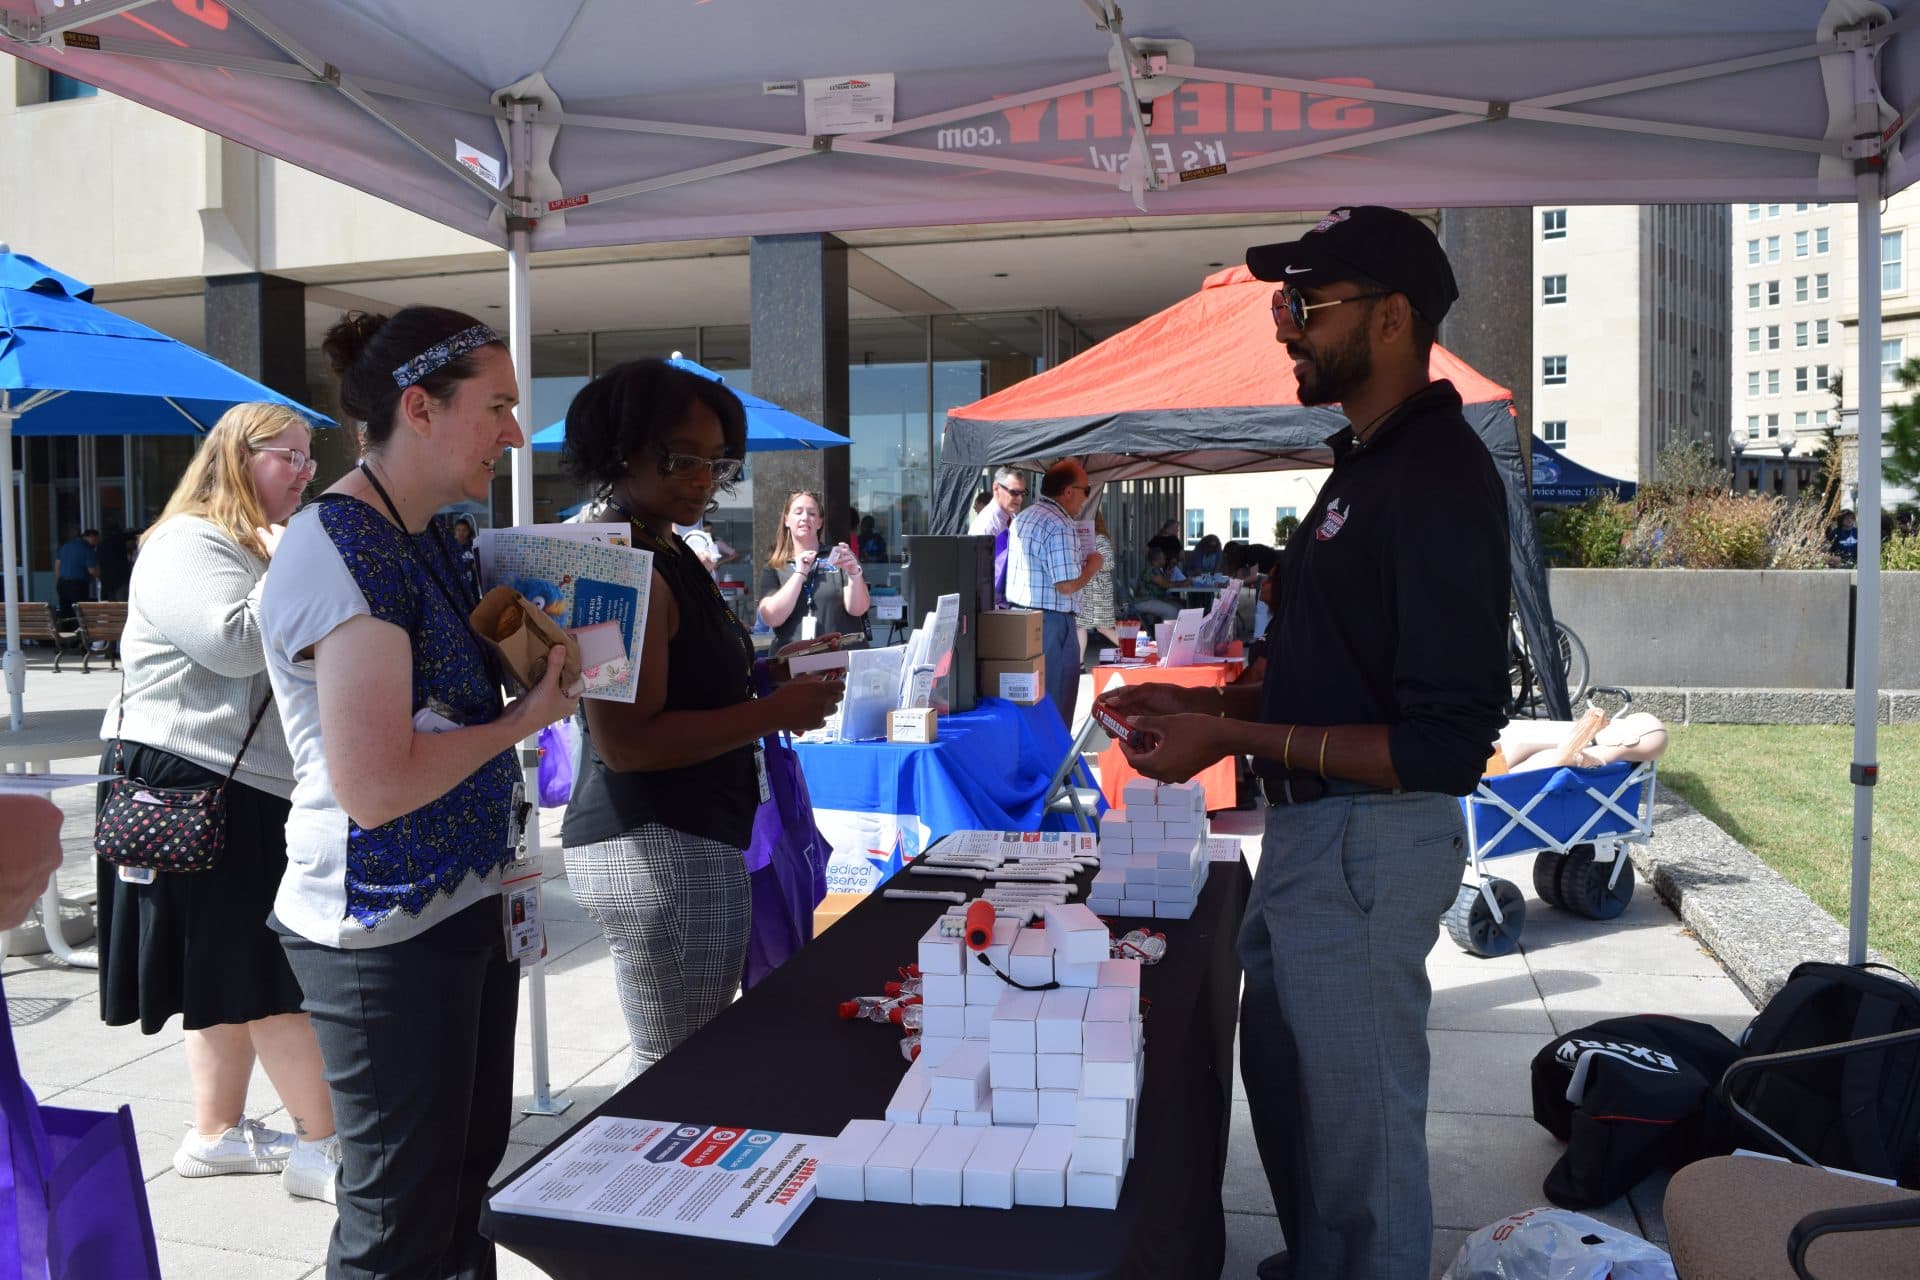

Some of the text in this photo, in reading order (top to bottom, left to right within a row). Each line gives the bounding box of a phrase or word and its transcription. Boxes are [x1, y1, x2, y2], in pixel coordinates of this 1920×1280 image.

[1532, 485, 1555, 496] rvice
[1557, 485, 1581, 496] since
[826, 877, 868, 887] eserve
